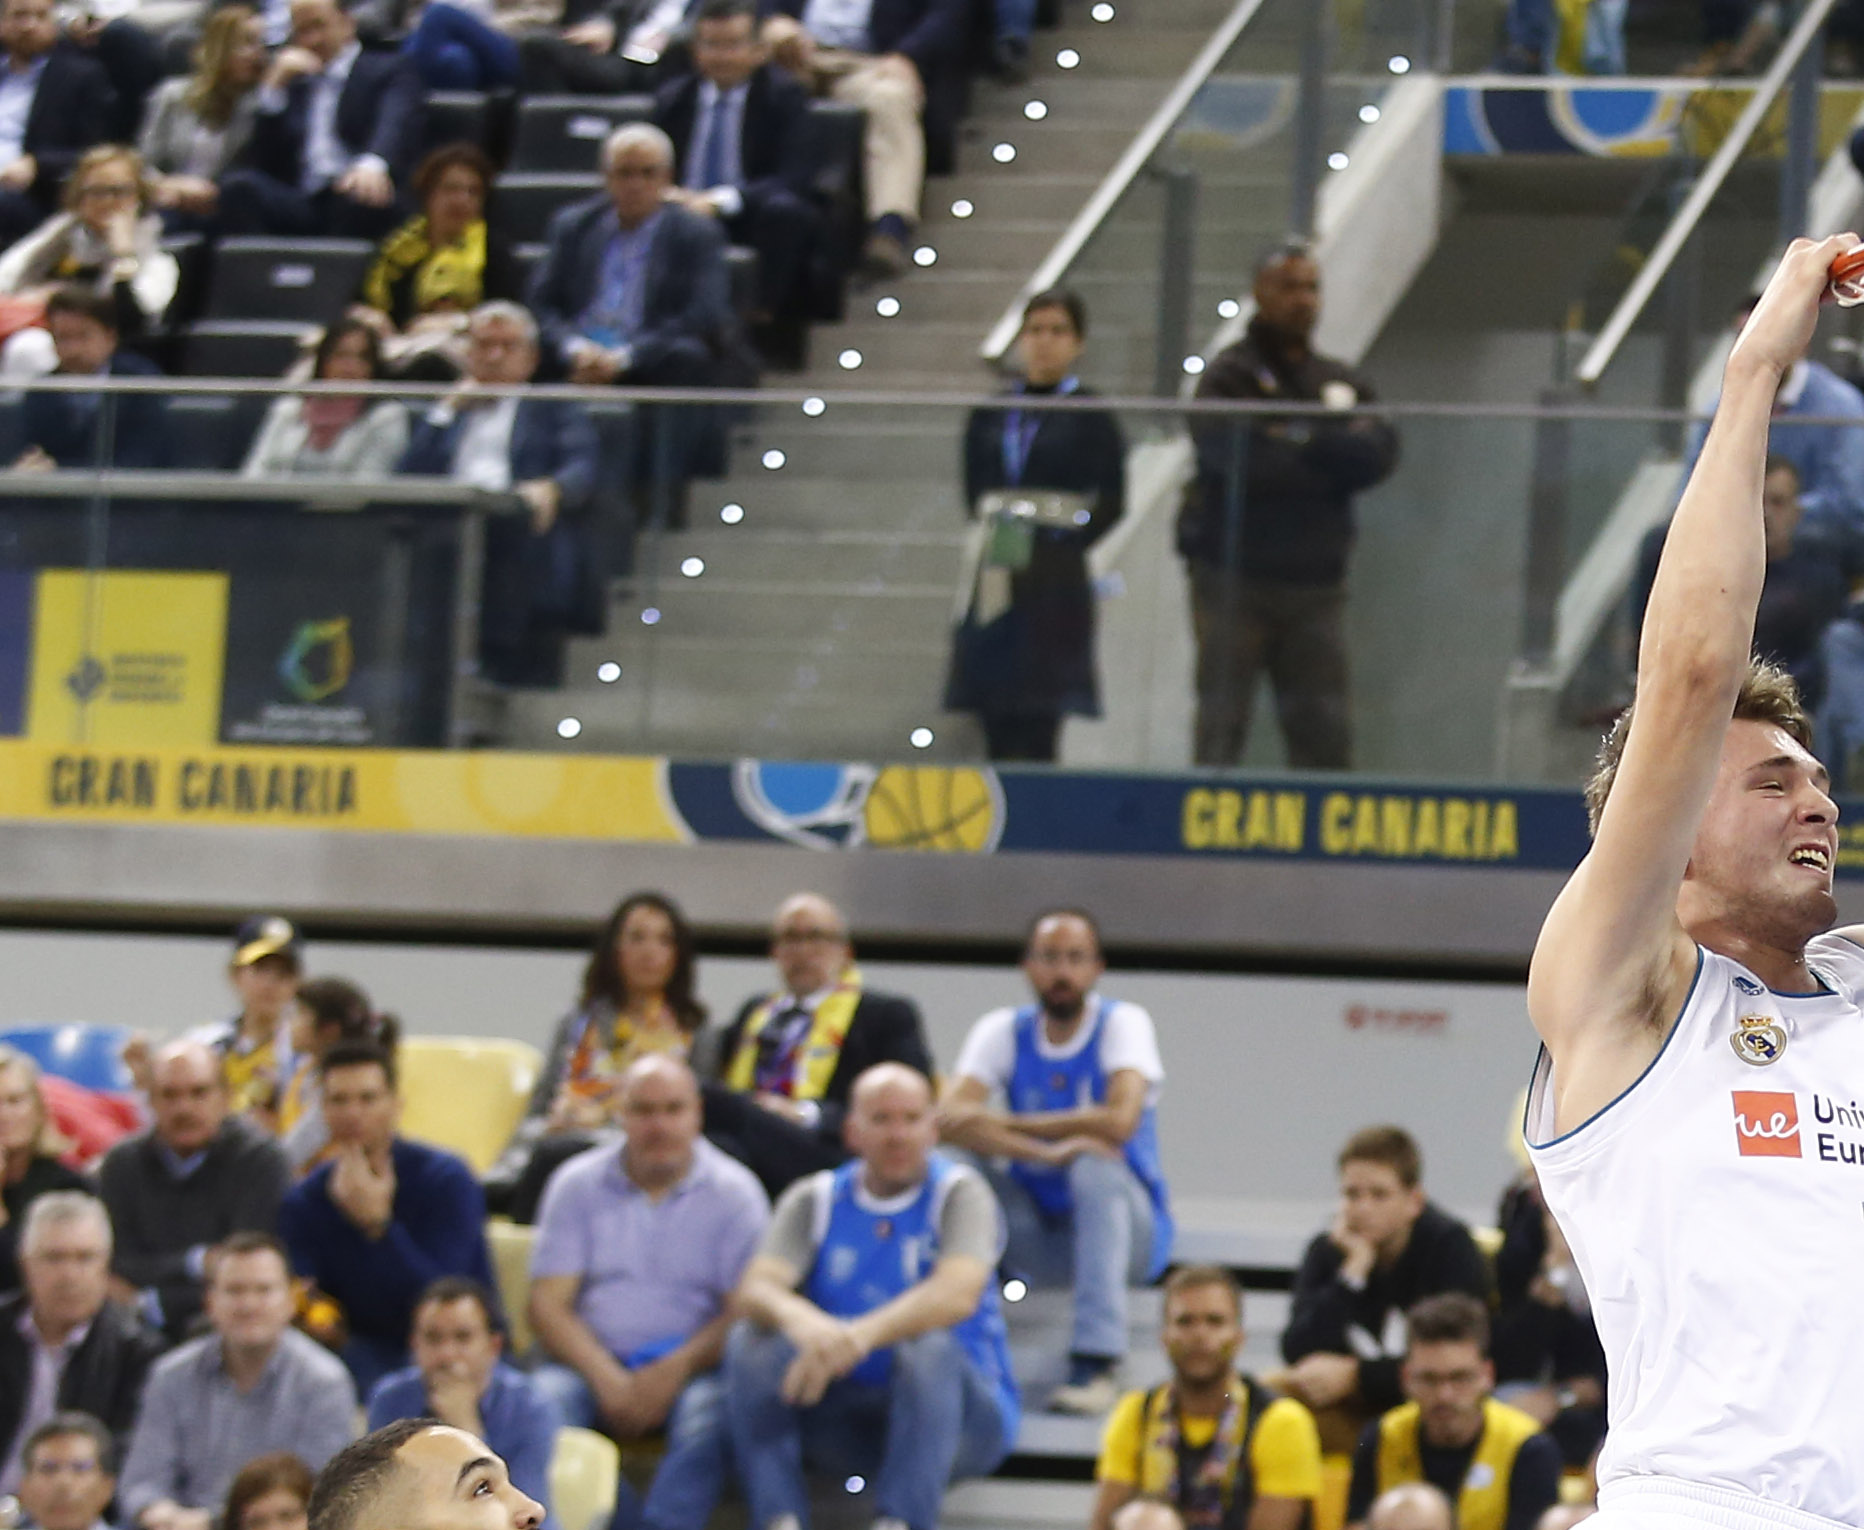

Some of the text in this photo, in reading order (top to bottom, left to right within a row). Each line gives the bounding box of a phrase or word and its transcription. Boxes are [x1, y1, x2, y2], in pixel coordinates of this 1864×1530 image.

[51, 755, 356, 815] GRAN CANARIA
[1181, 787, 1519, 861] GRAN CANARIA
